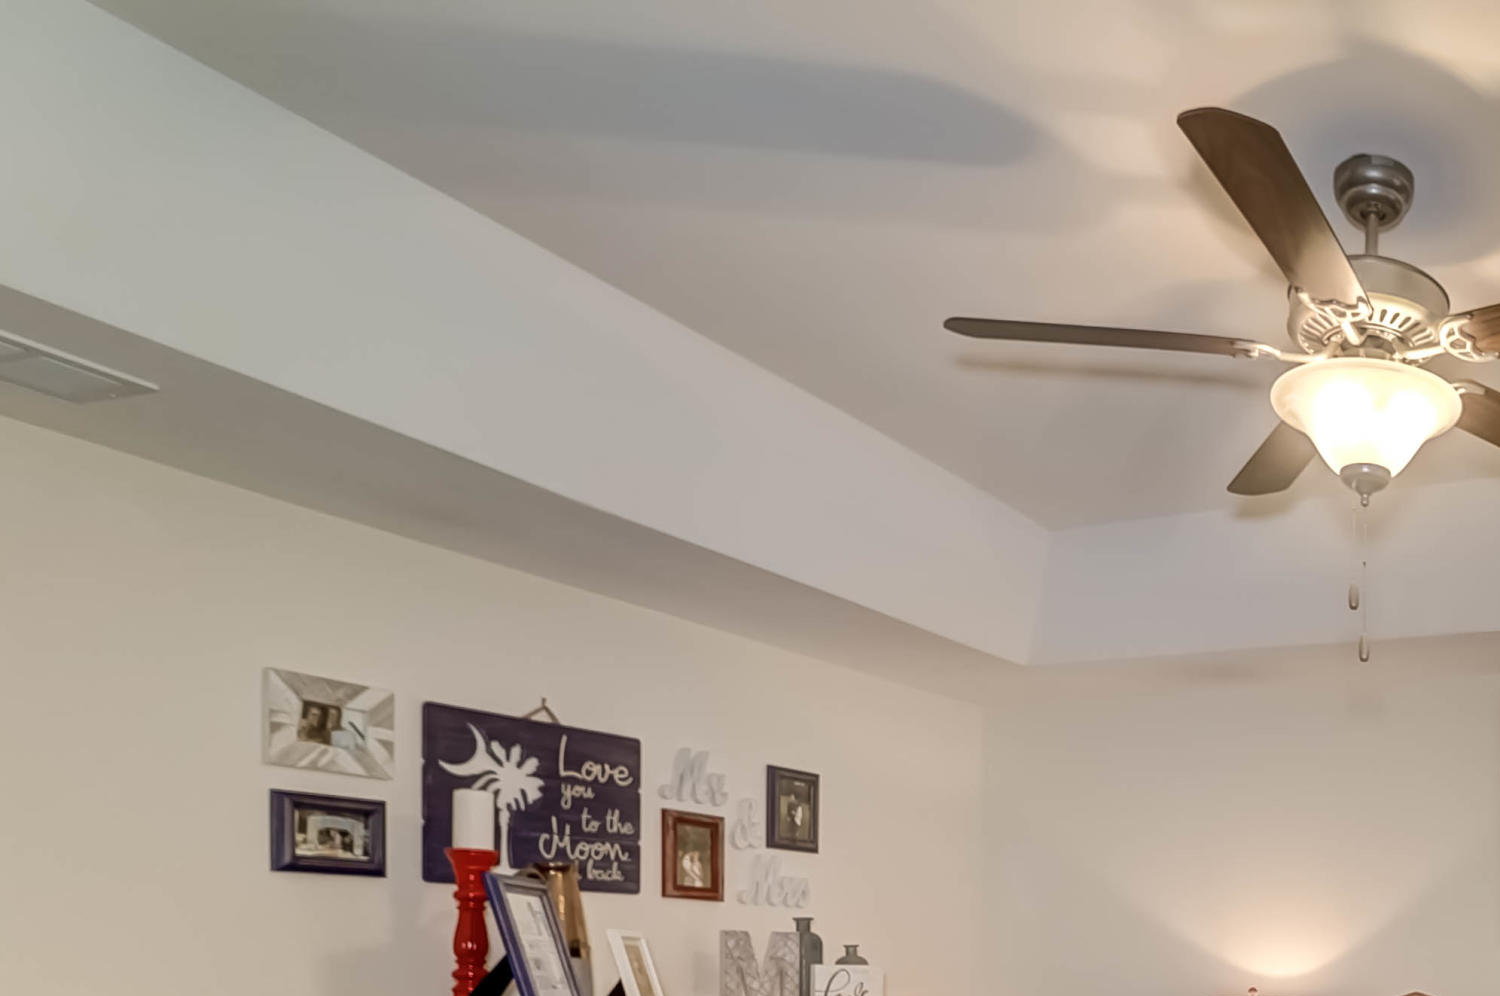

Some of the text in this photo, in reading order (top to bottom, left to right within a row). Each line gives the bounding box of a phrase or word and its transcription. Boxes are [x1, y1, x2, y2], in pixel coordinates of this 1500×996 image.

[557, 734, 634, 787] Love
[560, 783, 595, 810] you
[581, 807, 635, 834] to the
[538, 815, 631, 862] Moon
[586, 859, 625, 881] back
